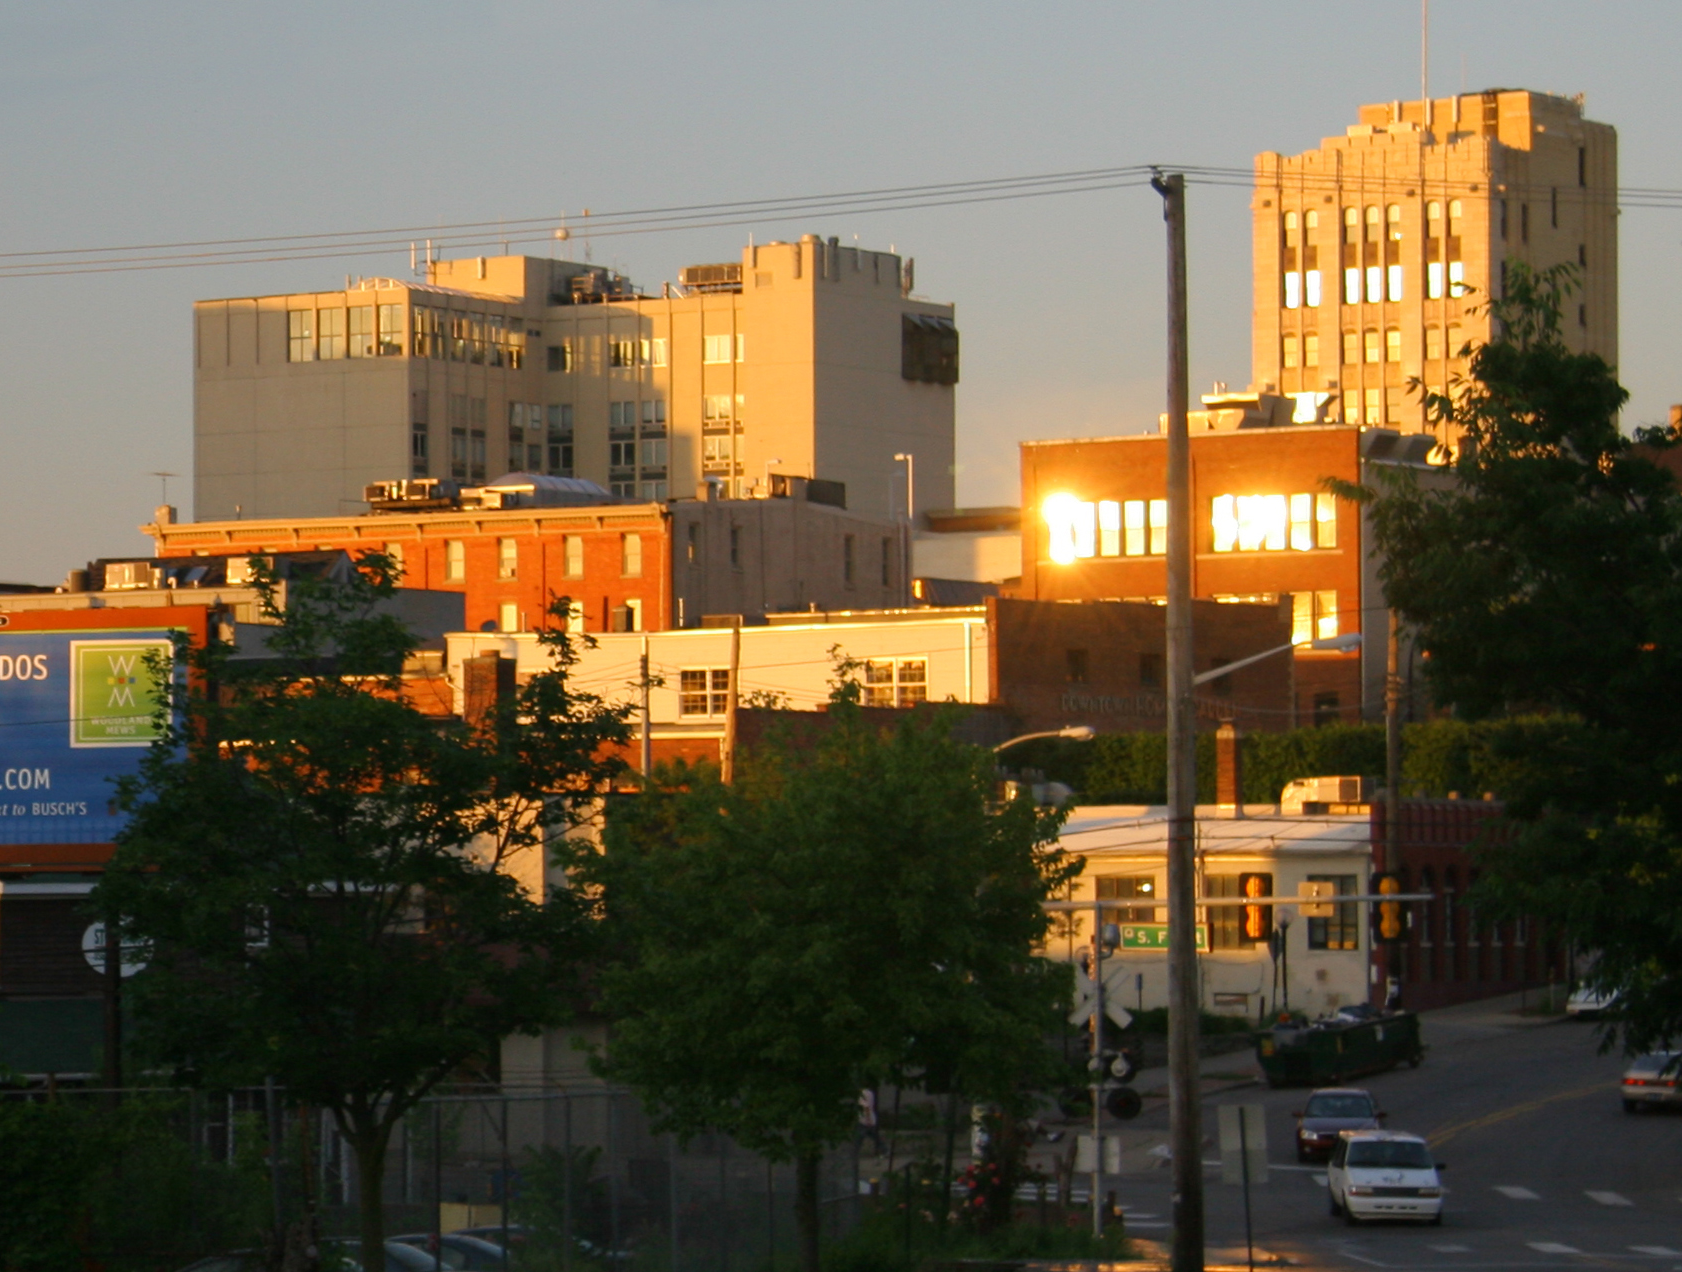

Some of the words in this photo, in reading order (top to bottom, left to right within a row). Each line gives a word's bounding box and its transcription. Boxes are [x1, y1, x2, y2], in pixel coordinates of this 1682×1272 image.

[108, 655, 135, 676] W
[107, 687, 135, 708] M
[12, 803, 26, 815] to
[32, 802, 87, 815] BUSCH'S
[1137, 931, 1150, 943] S.
